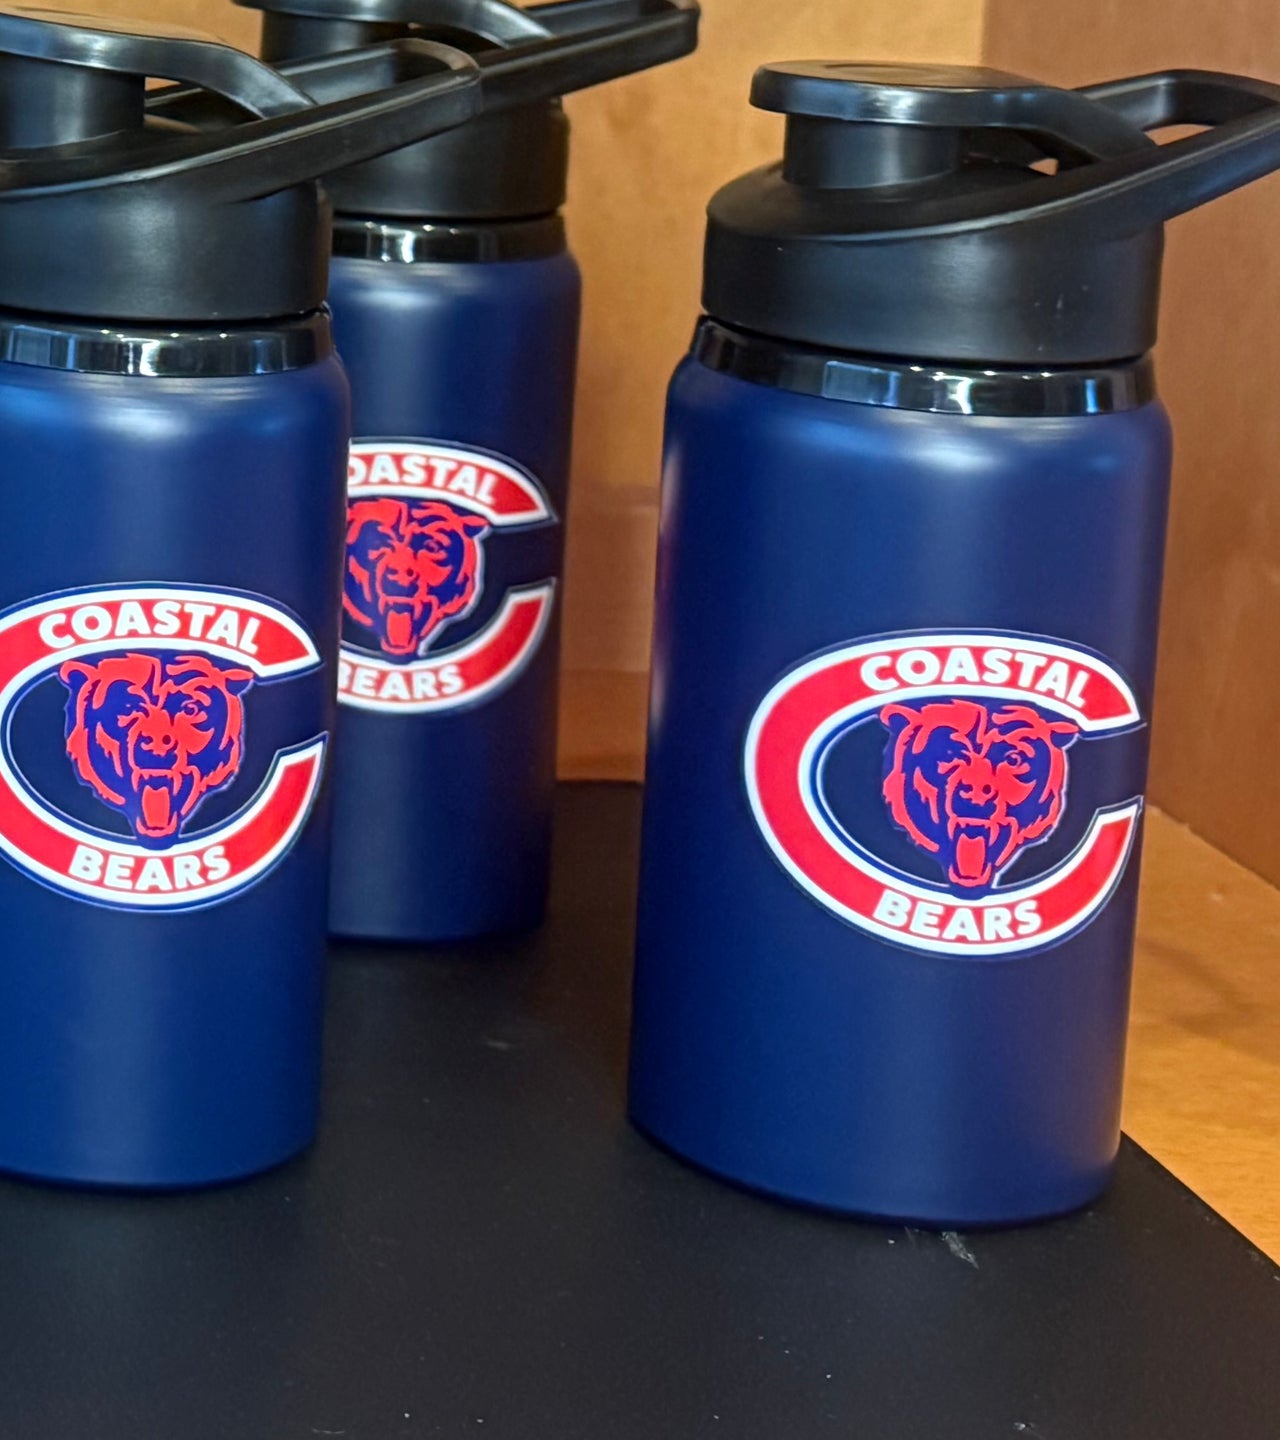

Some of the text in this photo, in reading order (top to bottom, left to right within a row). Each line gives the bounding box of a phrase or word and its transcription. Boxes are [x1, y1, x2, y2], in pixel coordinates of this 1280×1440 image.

[348, 454, 497, 504] OASTAL
[39, 600, 261, 655] COASTAL
[860, 646, 1090, 708] COASTAL
[68, 844, 232, 892] BEARS
[872, 888, 1042, 943] BEARS
